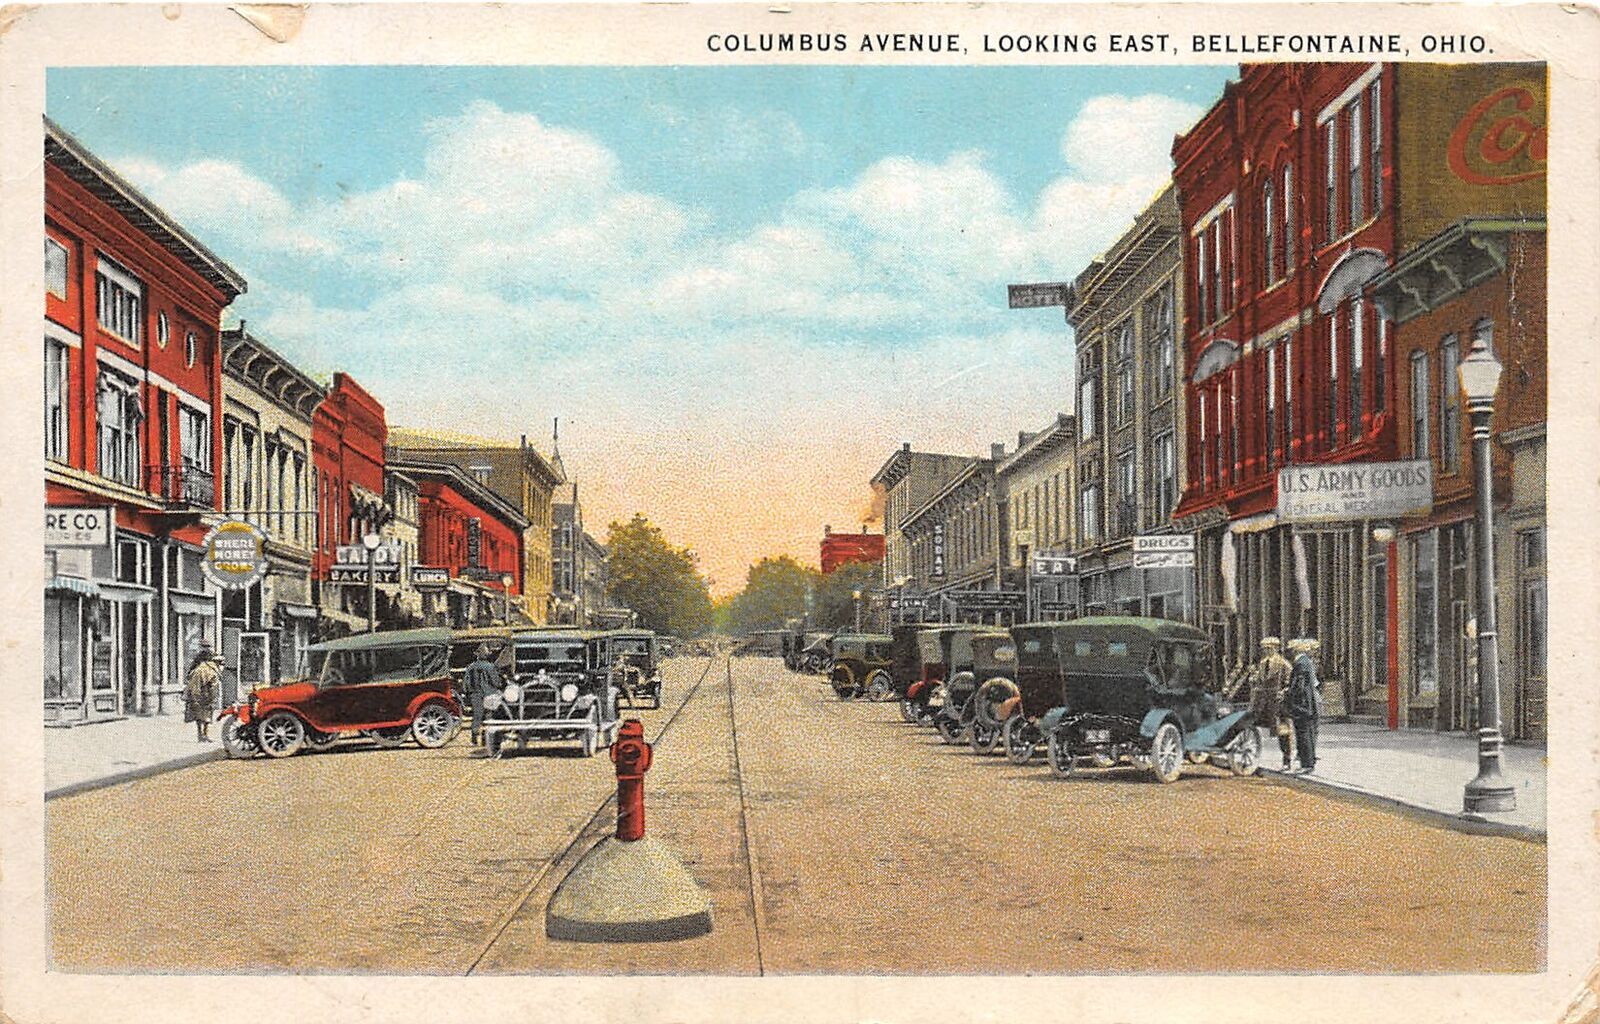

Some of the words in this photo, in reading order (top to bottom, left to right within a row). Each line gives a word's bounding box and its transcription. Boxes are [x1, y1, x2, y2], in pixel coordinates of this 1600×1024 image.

[1316, 469, 1366, 492] ARMY
[1371, 466, 1427, 489] GOODS
[46, 513, 68, 530] RE
[73, 513, 102, 530] CO.
[933, 525, 944, 575] SODAS
[1138, 537, 1190, 549] DRUGS
[214, 549, 256, 559] MONEY
[1036, 559, 1077, 574] EAT
[413, 573, 448, 582] LUNCH
